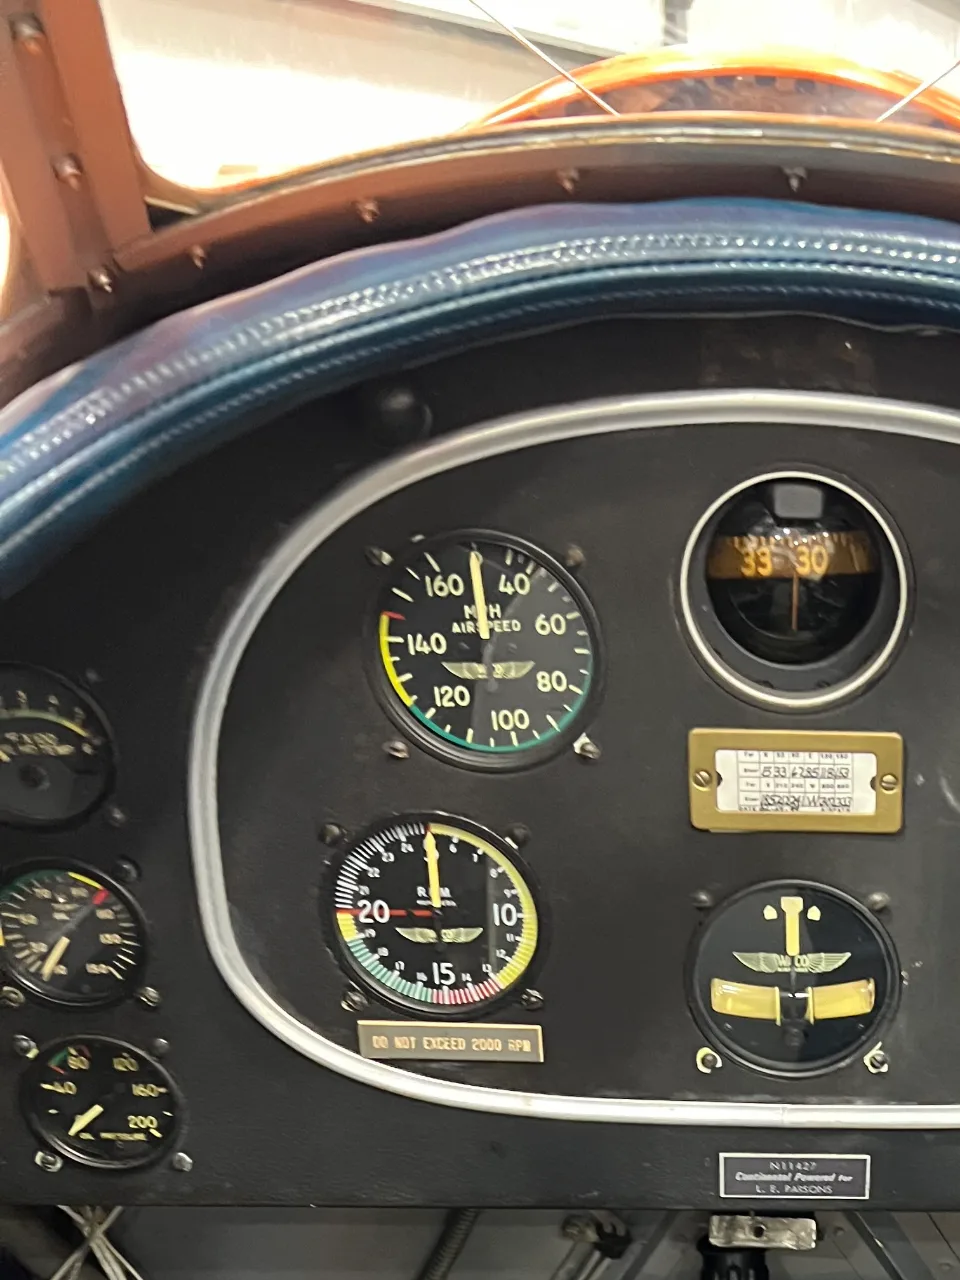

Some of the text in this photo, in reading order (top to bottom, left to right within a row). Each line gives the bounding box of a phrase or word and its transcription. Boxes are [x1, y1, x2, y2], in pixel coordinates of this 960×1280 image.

[741, 544, 828, 576] 33 30
[424, 573, 464, 597] 160
[499, 573, 530, 595] 40
[463, 603, 502, 619] MH
[451, 619, 522, 634] AIRPEED
[535, 613, 566, 635] 60
[407, 632, 447, 655] 140
[536, 671, 567, 692] 80
[433, 685, 471, 708] 120
[491, 708, 530, 730] 100
[416, 886, 452, 898] RM
[357, 899, 390, 923] 20
[493, 903, 517, 926] 10
[432, 962, 456, 985] 15
[372, 1036, 531, 1052] DO NOT EXCEED 2000 RPM
[127, 1115, 158, 1129] 200
[784, 1185, 833, 1194] PARSONS
